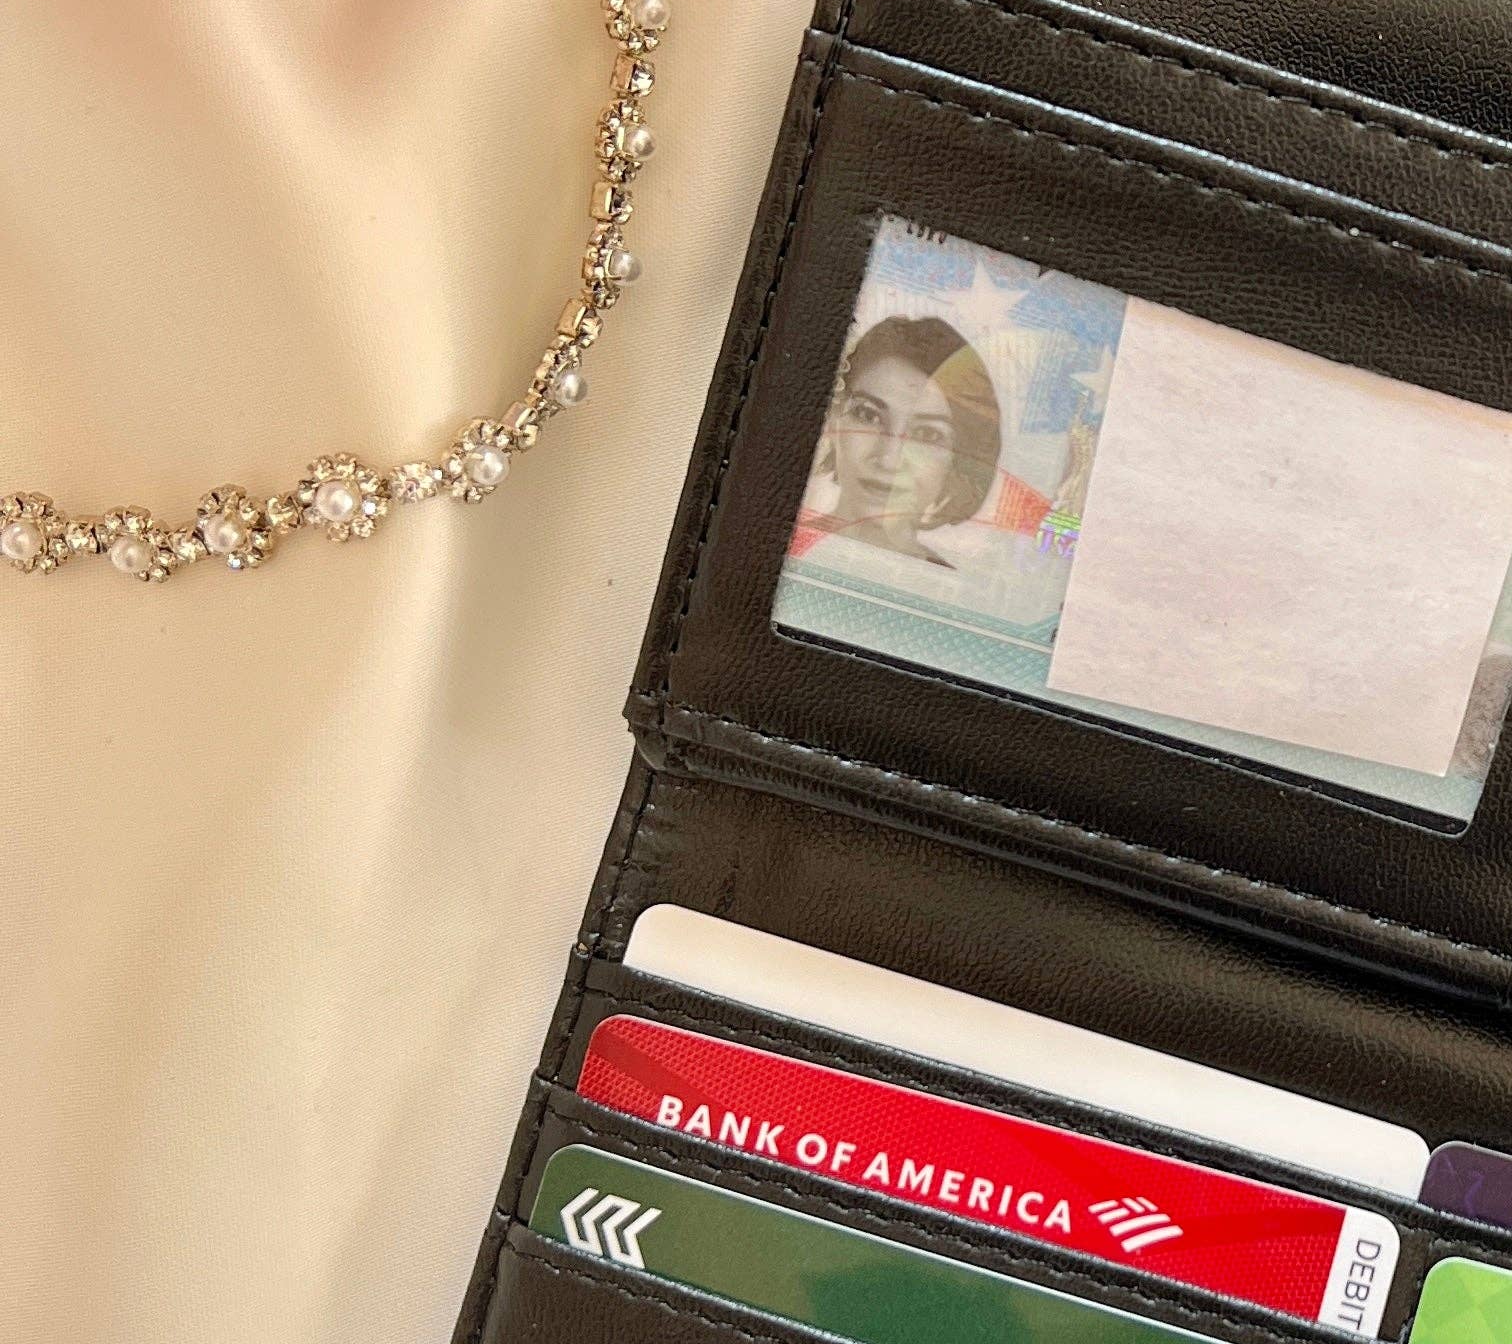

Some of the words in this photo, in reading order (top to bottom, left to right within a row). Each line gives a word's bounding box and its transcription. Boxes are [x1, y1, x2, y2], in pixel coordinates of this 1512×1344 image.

[656, 1094, 786, 1156] BANK
[795, 1132, 857, 1172] OF
[862, 1151, 1072, 1235] AMERICA
[1337, 1239, 1382, 1331] DEBIT
